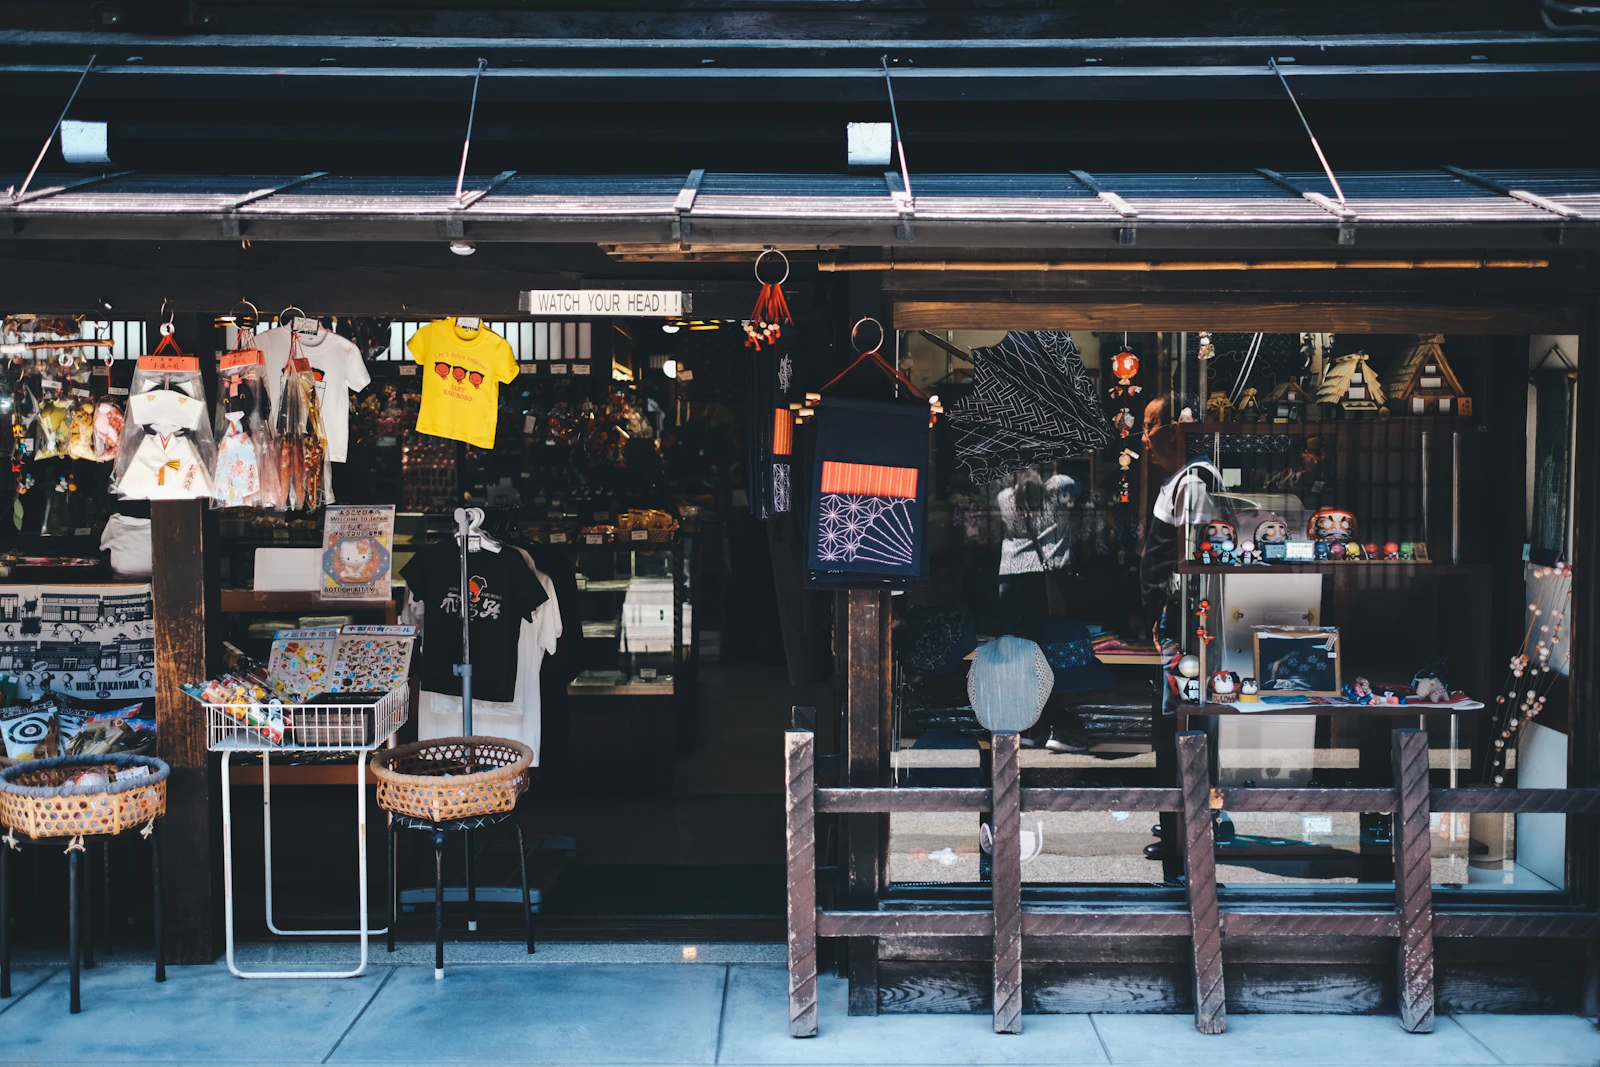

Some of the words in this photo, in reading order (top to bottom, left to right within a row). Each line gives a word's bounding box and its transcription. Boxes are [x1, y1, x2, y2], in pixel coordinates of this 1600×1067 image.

[538, 293, 580, 312] WATCH
[587, 293, 620, 312] YOUR
[75, 681, 96, 691] HIDA
[97, 680, 139, 691] TAKAYAMA
